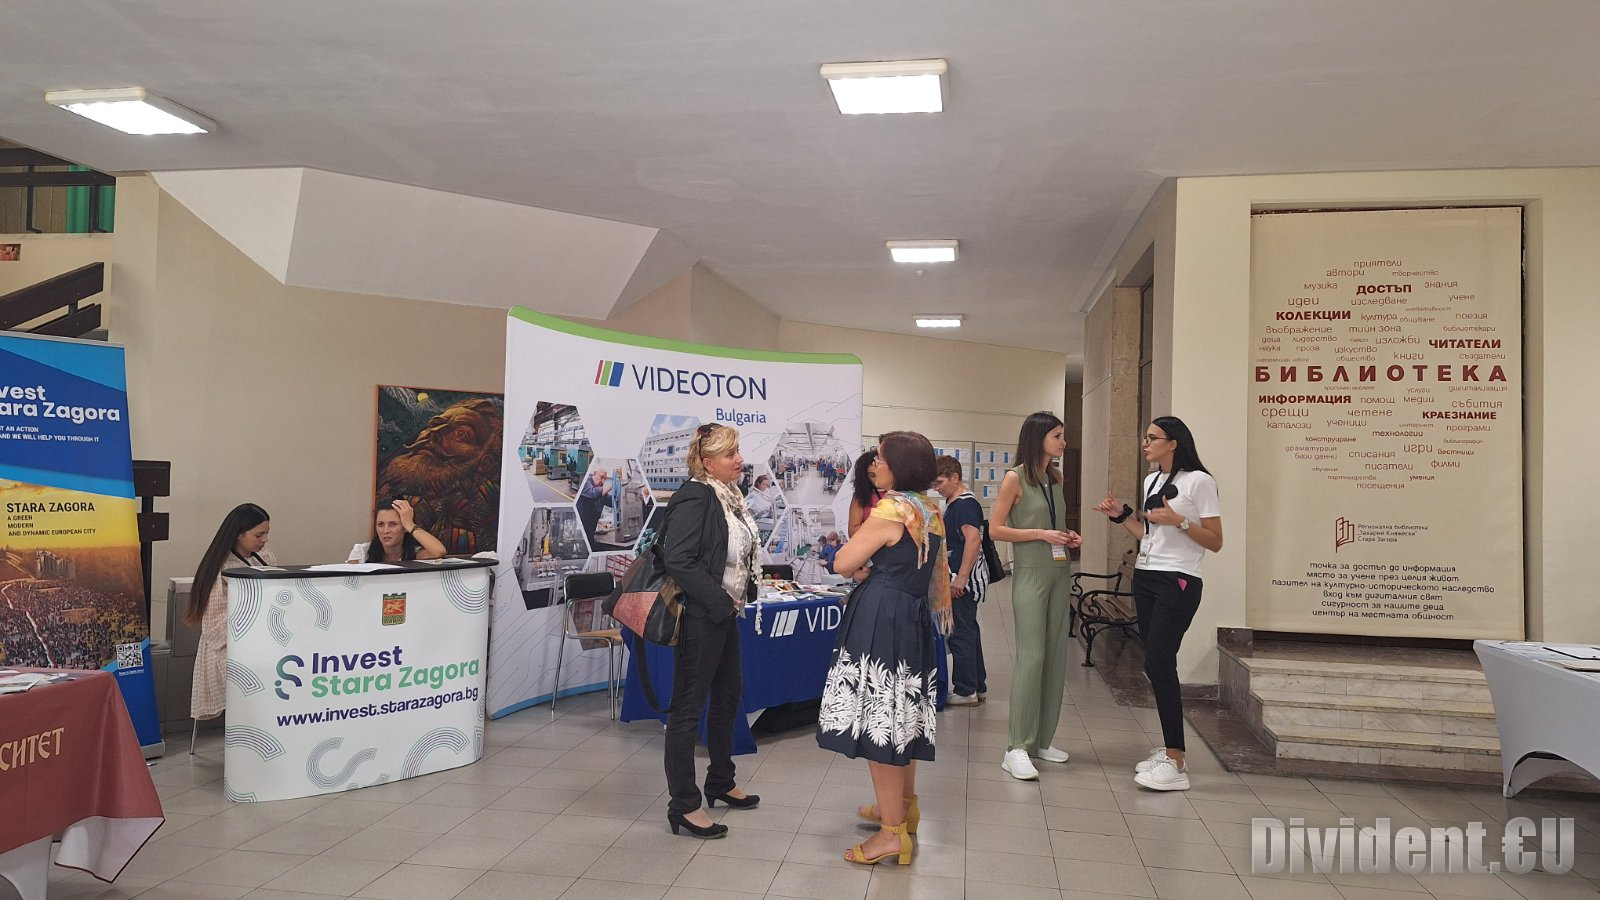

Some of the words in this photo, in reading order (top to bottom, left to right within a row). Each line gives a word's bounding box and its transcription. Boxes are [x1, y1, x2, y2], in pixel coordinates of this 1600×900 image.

[1354, 260, 1402, 268] приятели
[1326, 269, 1365, 277] автори
[1392, 269, 1439, 277] творчество
[1304, 281, 1338, 291] музика
[1356, 284, 1412, 295] ДОСТЪП
[1424, 281, 1458, 289] знания
[1287, 297, 1319, 307] идеи
[1351, 296, 1408, 306] изследване
[1448, 294, 1475, 302] учене
[1276, 310, 1351, 321] КОЛЕКЦИИ
[1361, 313, 1398, 322] култура
[1456, 312, 1488, 320] поезия
[1265, 325, 1333, 335] въображение
[1349, 325, 1376, 333] тийн
[1292, 335, 1338, 343] лидерство
[1375, 335, 1421, 344] изложби
[1428, 339, 1501, 349] ЧИТАТЕЛИ
[1334, 345, 1378, 354] изкуство
[1336, 354, 1376, 362] общество
[1393, 351, 1424, 360] книги
[1459, 352, 1506, 361] създатели
[1255, 364, 1507, 382] БИБЛИОТЕКА
[631, 363, 767, 401] VIDEOTON
[1258, 394, 1352, 405] ИНФОРМАЦИЯ
[1360, 396, 1396, 404] помощ
[1403, 396, 1435, 404] медии
[1451, 398, 1503, 408] събития
[43, 402, 120, 424] Zagora
[715, 408, 767, 425] Bulgaria
[1261, 407, 1309, 419] срещи
[1347, 409, 1393, 417] четене
[1422, 411, 1497, 420] КРАЕЗНАНИЕ
[1267, 421, 1312, 429] каталози
[1326, 419, 1367, 428] ученици
[1446, 424, 1491, 433] програми
[1403, 443, 1433, 454] игри
[1437, 448, 1475, 456] вестници
[1365, 462, 1414, 470] писатели
[1430, 459, 1461, 469] филми
[1356, 482, 1405, 490] посещения
[6, 502, 46, 513] STARA
[49, 502, 95, 512] ZAGORA
[1402, 564, 1456, 573] информация
[1306, 571, 1336, 579] място
[1401, 574, 1427, 582] целия
[1272, 579, 1309, 587] пазител
[1324, 581, 1439, 591] културно-историческото
[1442, 584, 1495, 593] наследство
[1323, 590, 1343, 599] вход
[1365, 592, 1417, 600] дигиталния
[1420, 593, 1443, 601] свят
[1321, 600, 1369, 609] сигурност
[1312, 609, 1346, 618] център
[1361, 611, 1409, 619] местната
[1411, 612, 1454, 620] общност
[312, 646, 403, 674] Invest
[311, 673, 392, 698] Stara
[398, 658, 480, 690] Zagora
[276, 686, 479, 727] www.invest.starazagora.bg
